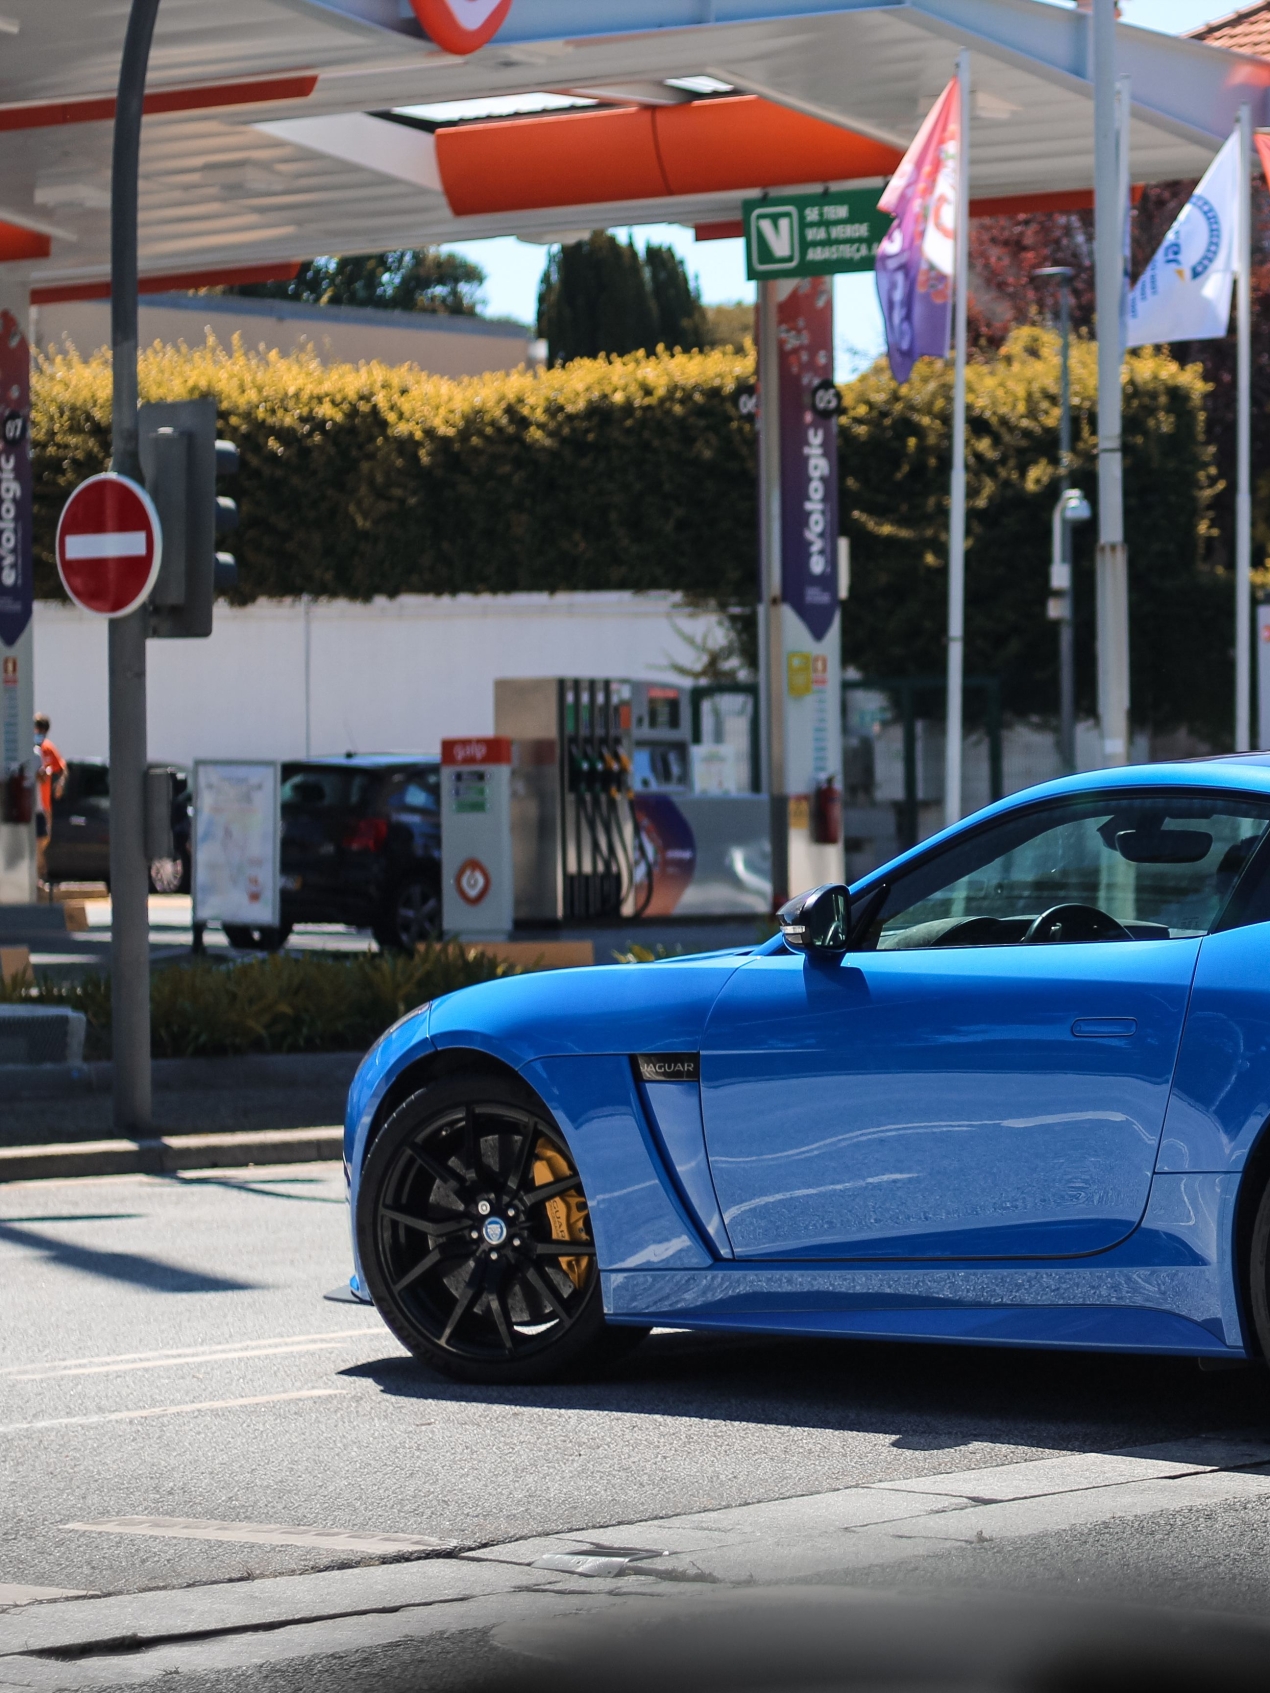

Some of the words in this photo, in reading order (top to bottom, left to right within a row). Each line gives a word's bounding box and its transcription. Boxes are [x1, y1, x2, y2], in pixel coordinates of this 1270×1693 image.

[804, 206, 820, 223] SE
[822, 204, 849, 221] TEM
[804, 225, 828, 242] VIA
[829, 222, 871, 241] VERDE
[805, 243, 869, 262] ABASTEÇA
[814, 388, 838, 410] 05
[803, 427, 830, 576] evologic
[0, 453, 21, 588] evologic
[641, 1062, 694, 1072] JAGUAR
